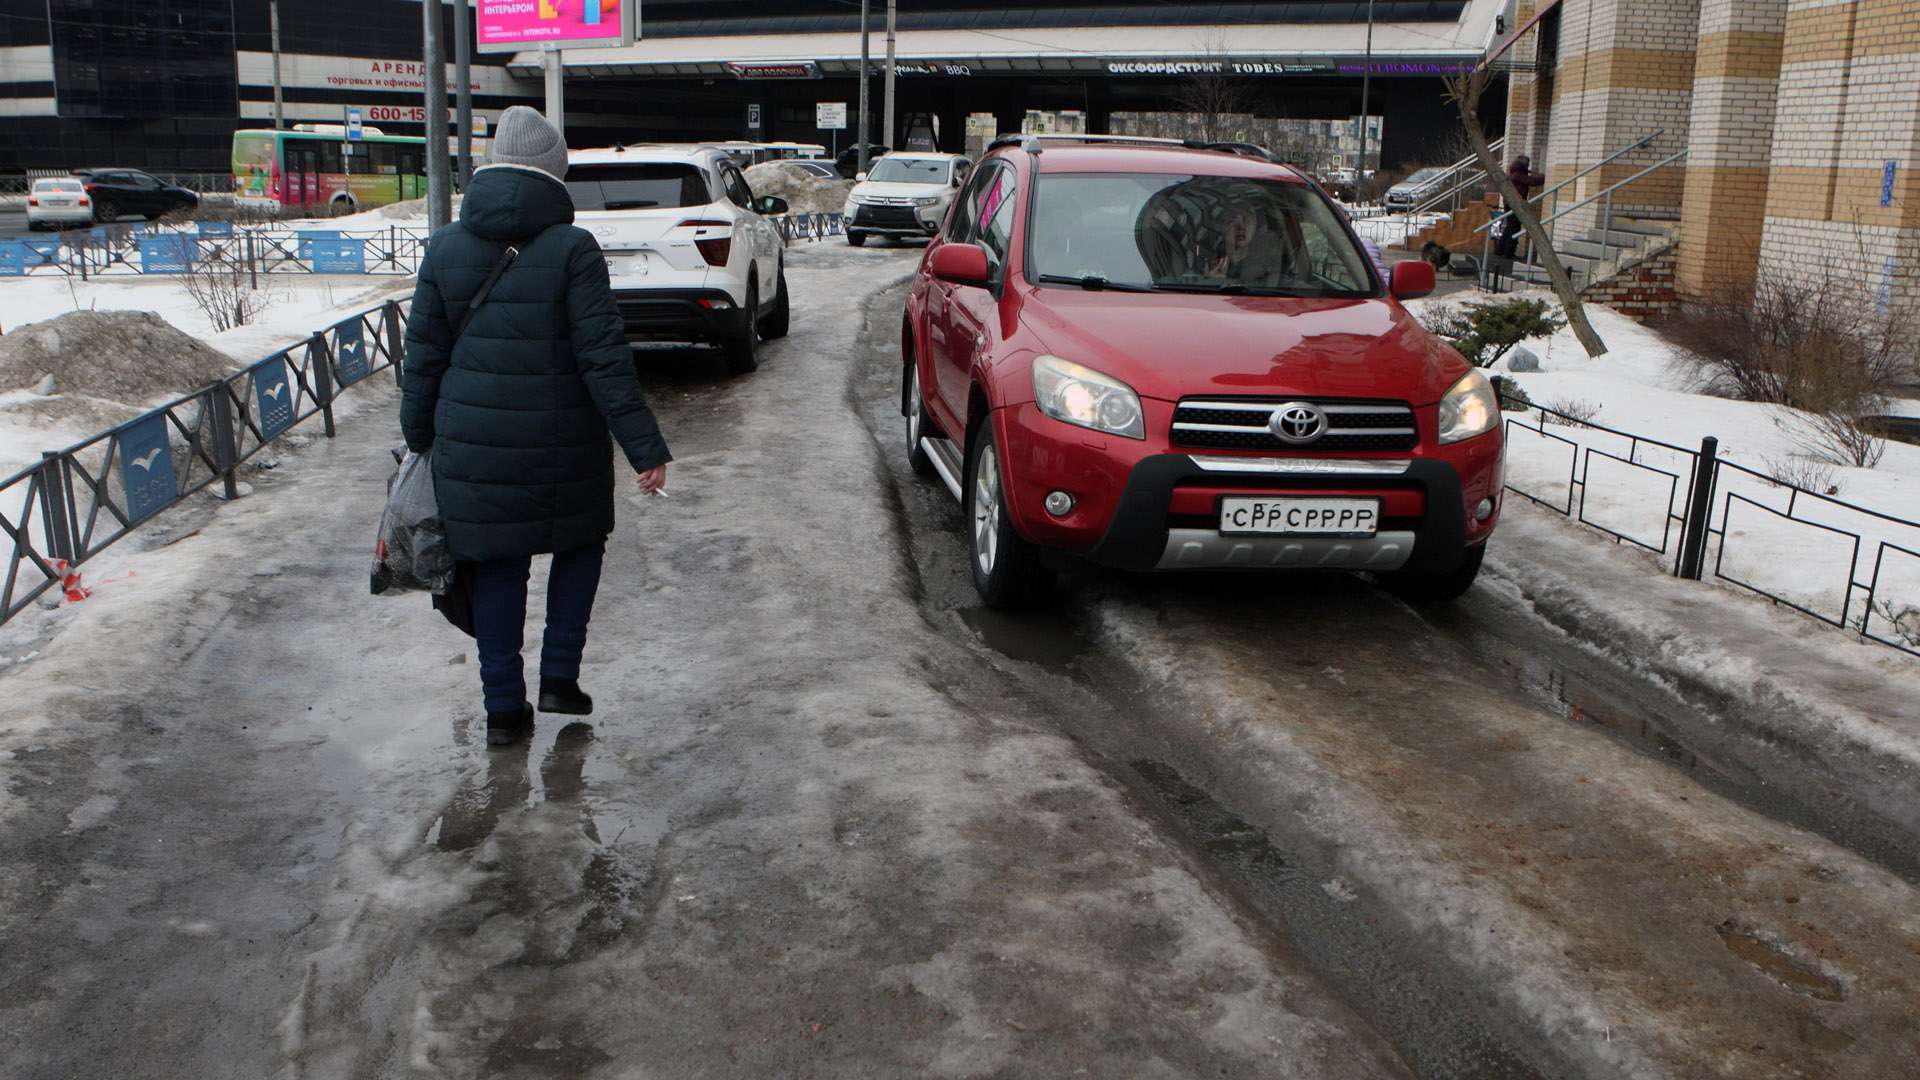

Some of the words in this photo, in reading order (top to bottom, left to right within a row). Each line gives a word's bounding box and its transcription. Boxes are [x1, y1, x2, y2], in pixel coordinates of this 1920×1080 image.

[484, 3, 534, 15] ИНТЕРЬЕРОМ
[371, 62, 425, 76] АРЕНД
[946, 65, 971, 76] BBQ
[1232, 63, 1284, 73] TODES
[327, 76, 373, 86] торговых
